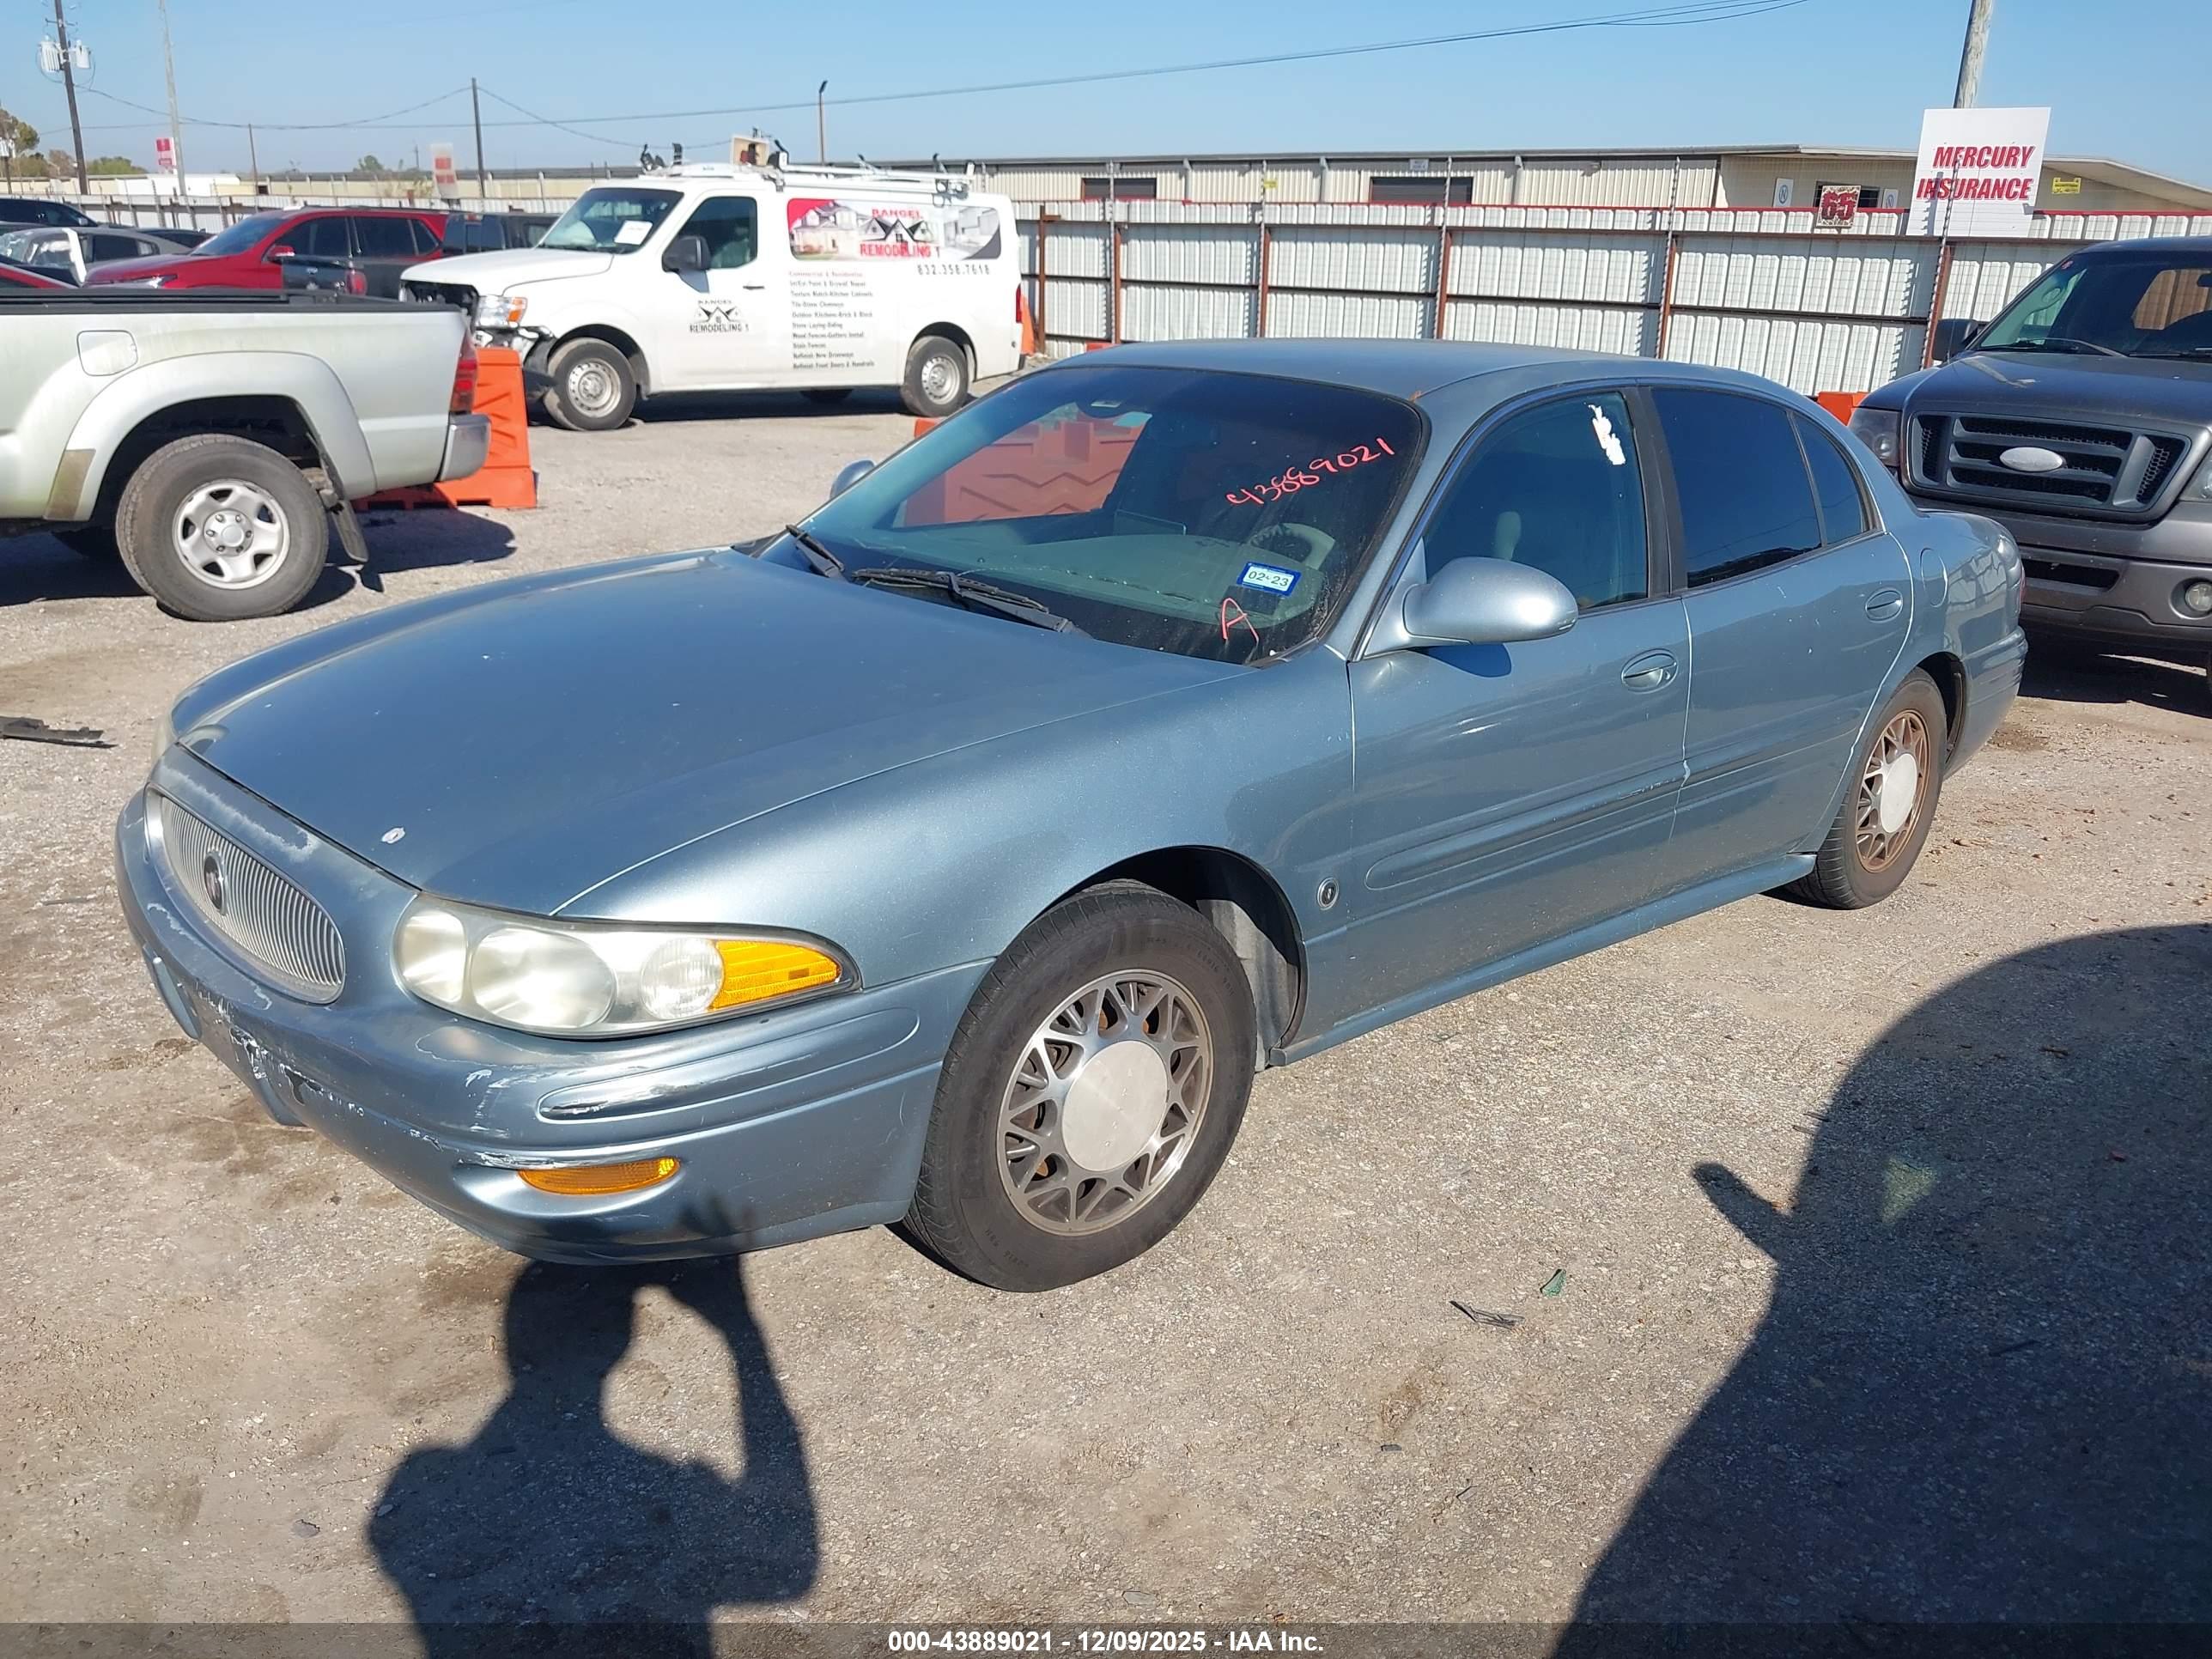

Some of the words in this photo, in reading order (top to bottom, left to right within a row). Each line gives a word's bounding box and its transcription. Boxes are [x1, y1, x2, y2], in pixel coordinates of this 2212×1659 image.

[1932, 146, 2036, 168] MERCURY
[1916, 178, 2034, 200] INSURANCE
[1820, 191, 1858, 220] 65
[860, 243, 931, 258] REMODELING
[1225, 437, 1395, 505] 43889021
[1221, 597, 1261, 642] A
